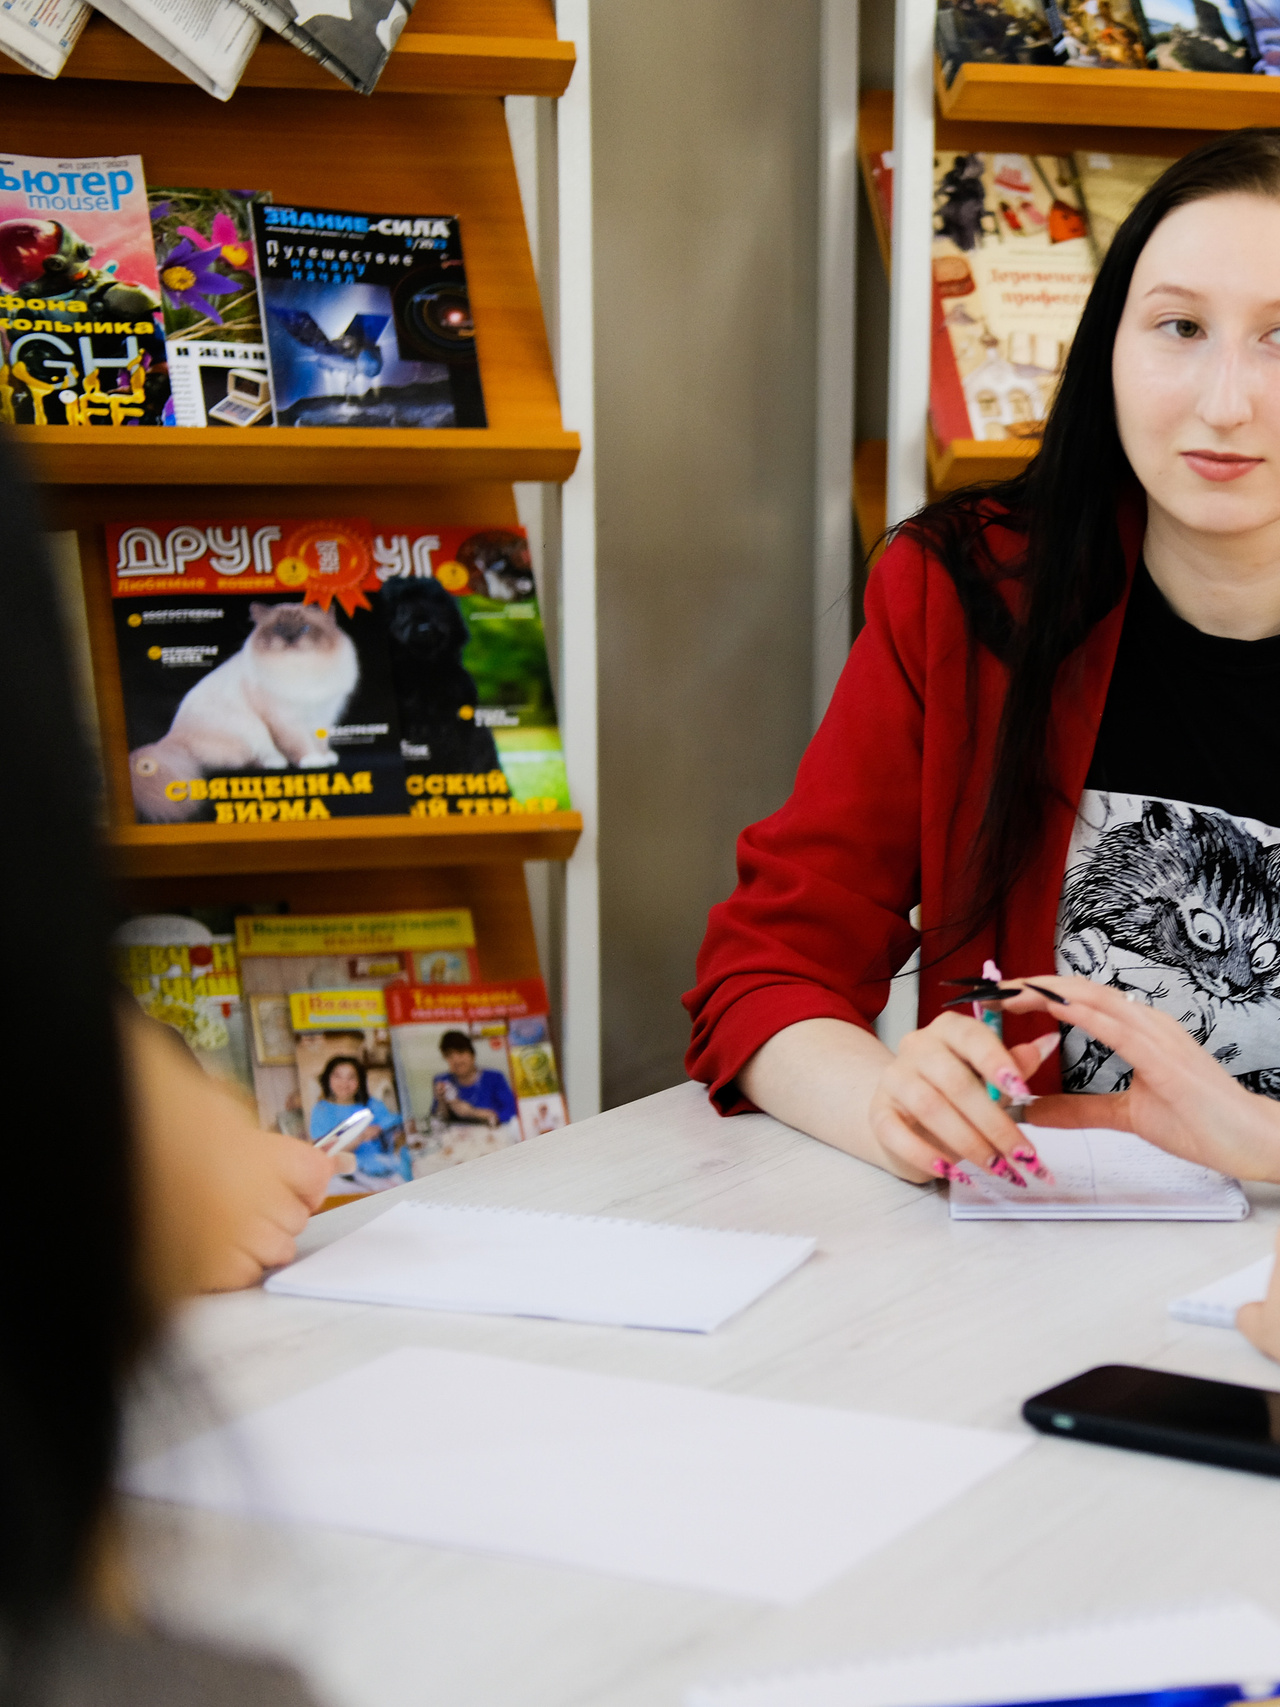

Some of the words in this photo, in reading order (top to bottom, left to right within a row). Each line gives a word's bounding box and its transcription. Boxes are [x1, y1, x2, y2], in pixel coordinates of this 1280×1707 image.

[28, 195, 109, 211] mouse
[266, 240, 414, 267] Путешествие
[117, 526, 282, 578] ДРУГ
[165, 771, 373, 802] СВЯЩЕННАЯ
[215, 798, 331, 824] БИРМА
